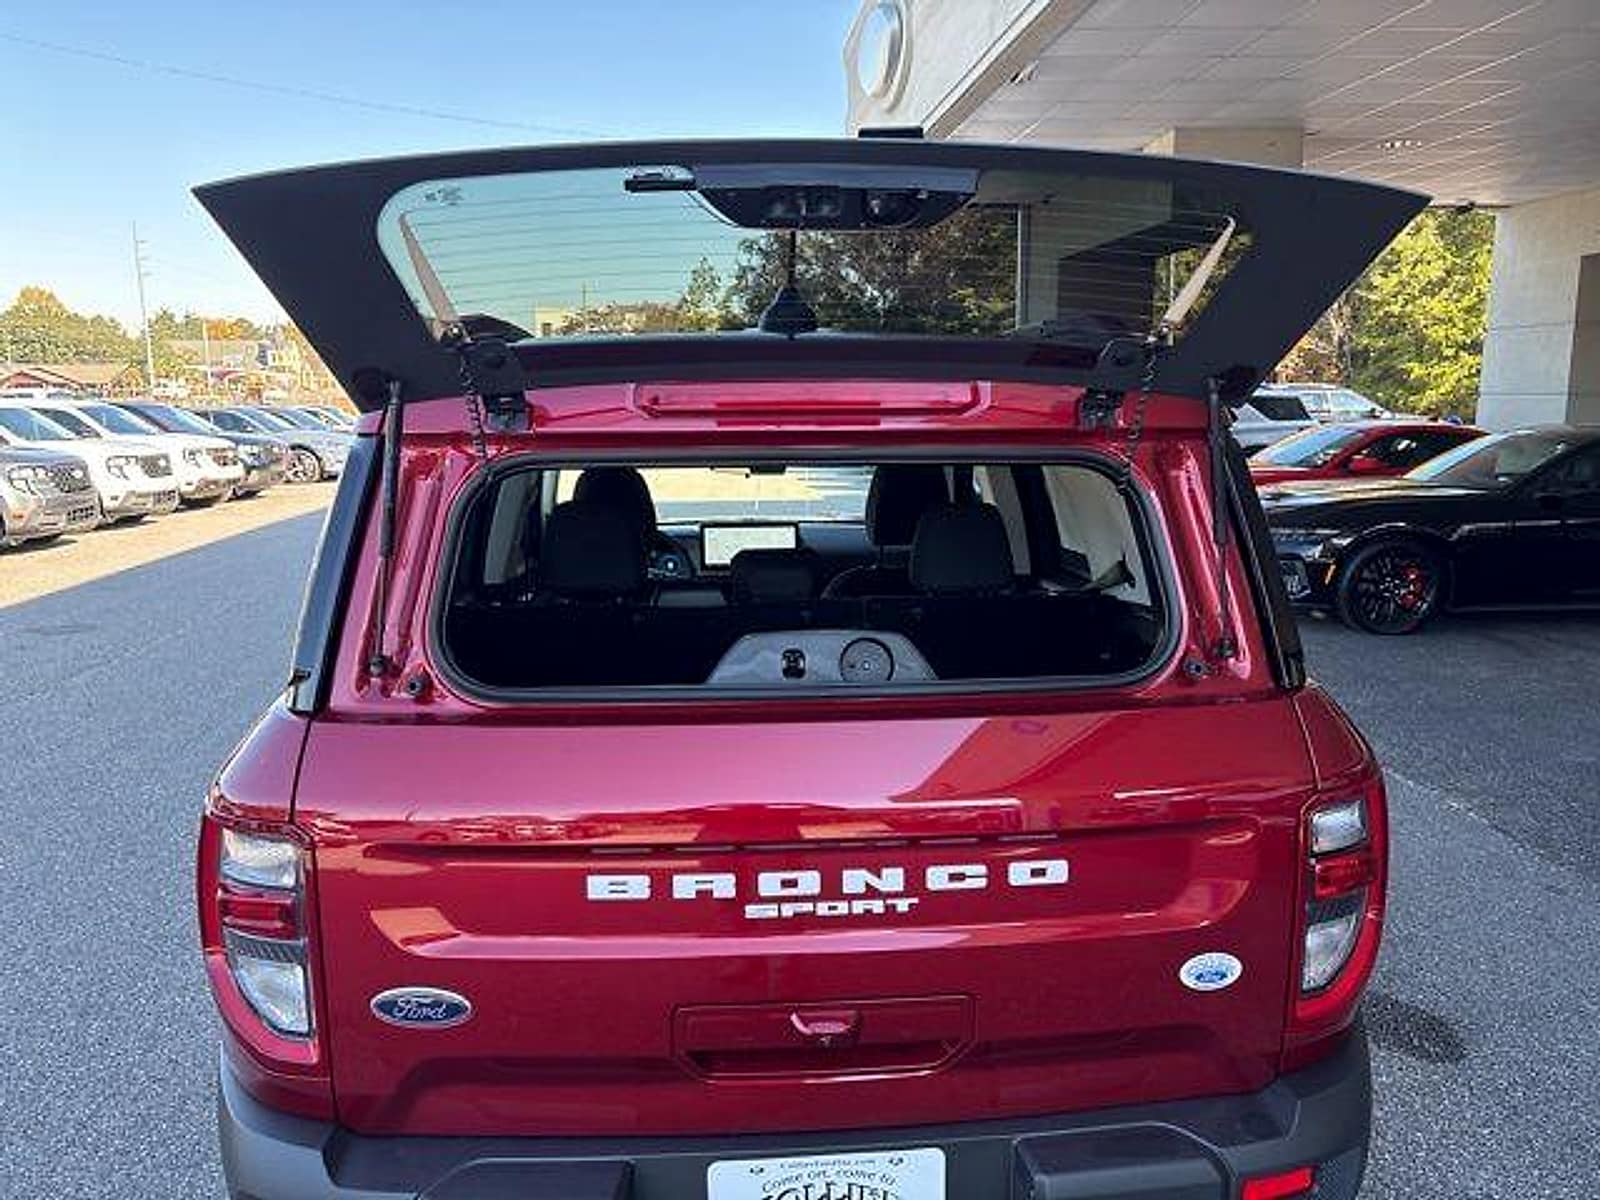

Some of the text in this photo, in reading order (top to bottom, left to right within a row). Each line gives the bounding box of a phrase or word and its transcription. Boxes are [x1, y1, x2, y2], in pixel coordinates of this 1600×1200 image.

[586, 859, 1069, 900] BRONCO
[744, 897, 919, 919] SPORT
[393, 996, 447, 1019] Ford
